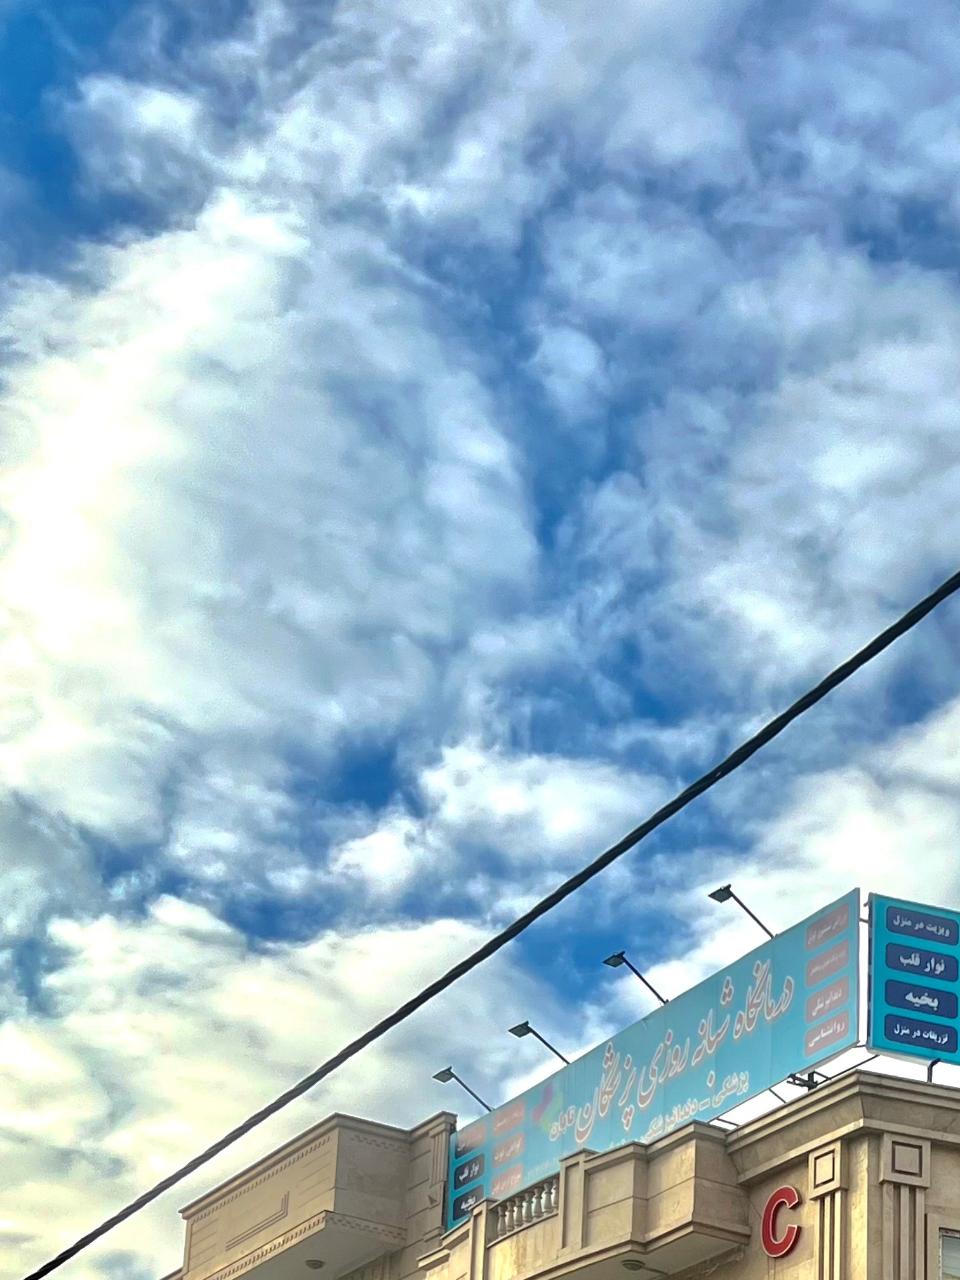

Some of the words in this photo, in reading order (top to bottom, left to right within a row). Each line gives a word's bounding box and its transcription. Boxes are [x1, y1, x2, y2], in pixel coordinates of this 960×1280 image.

[893, 914, 912, 928] منزل
[914, 921, 924, 931] در
[926, 921, 950, 937] ویزیت
[899, 952, 920, 967] قلب
[924, 957, 945, 974] نوار
[733, 958, 794, 1040] درمانگاه
[905, 990, 939, 1010] بخیه
[894, 1022, 911, 1035] منزل
[912, 1029, 921, 1039] در
[637, 1029, 690, 1108] روزی
